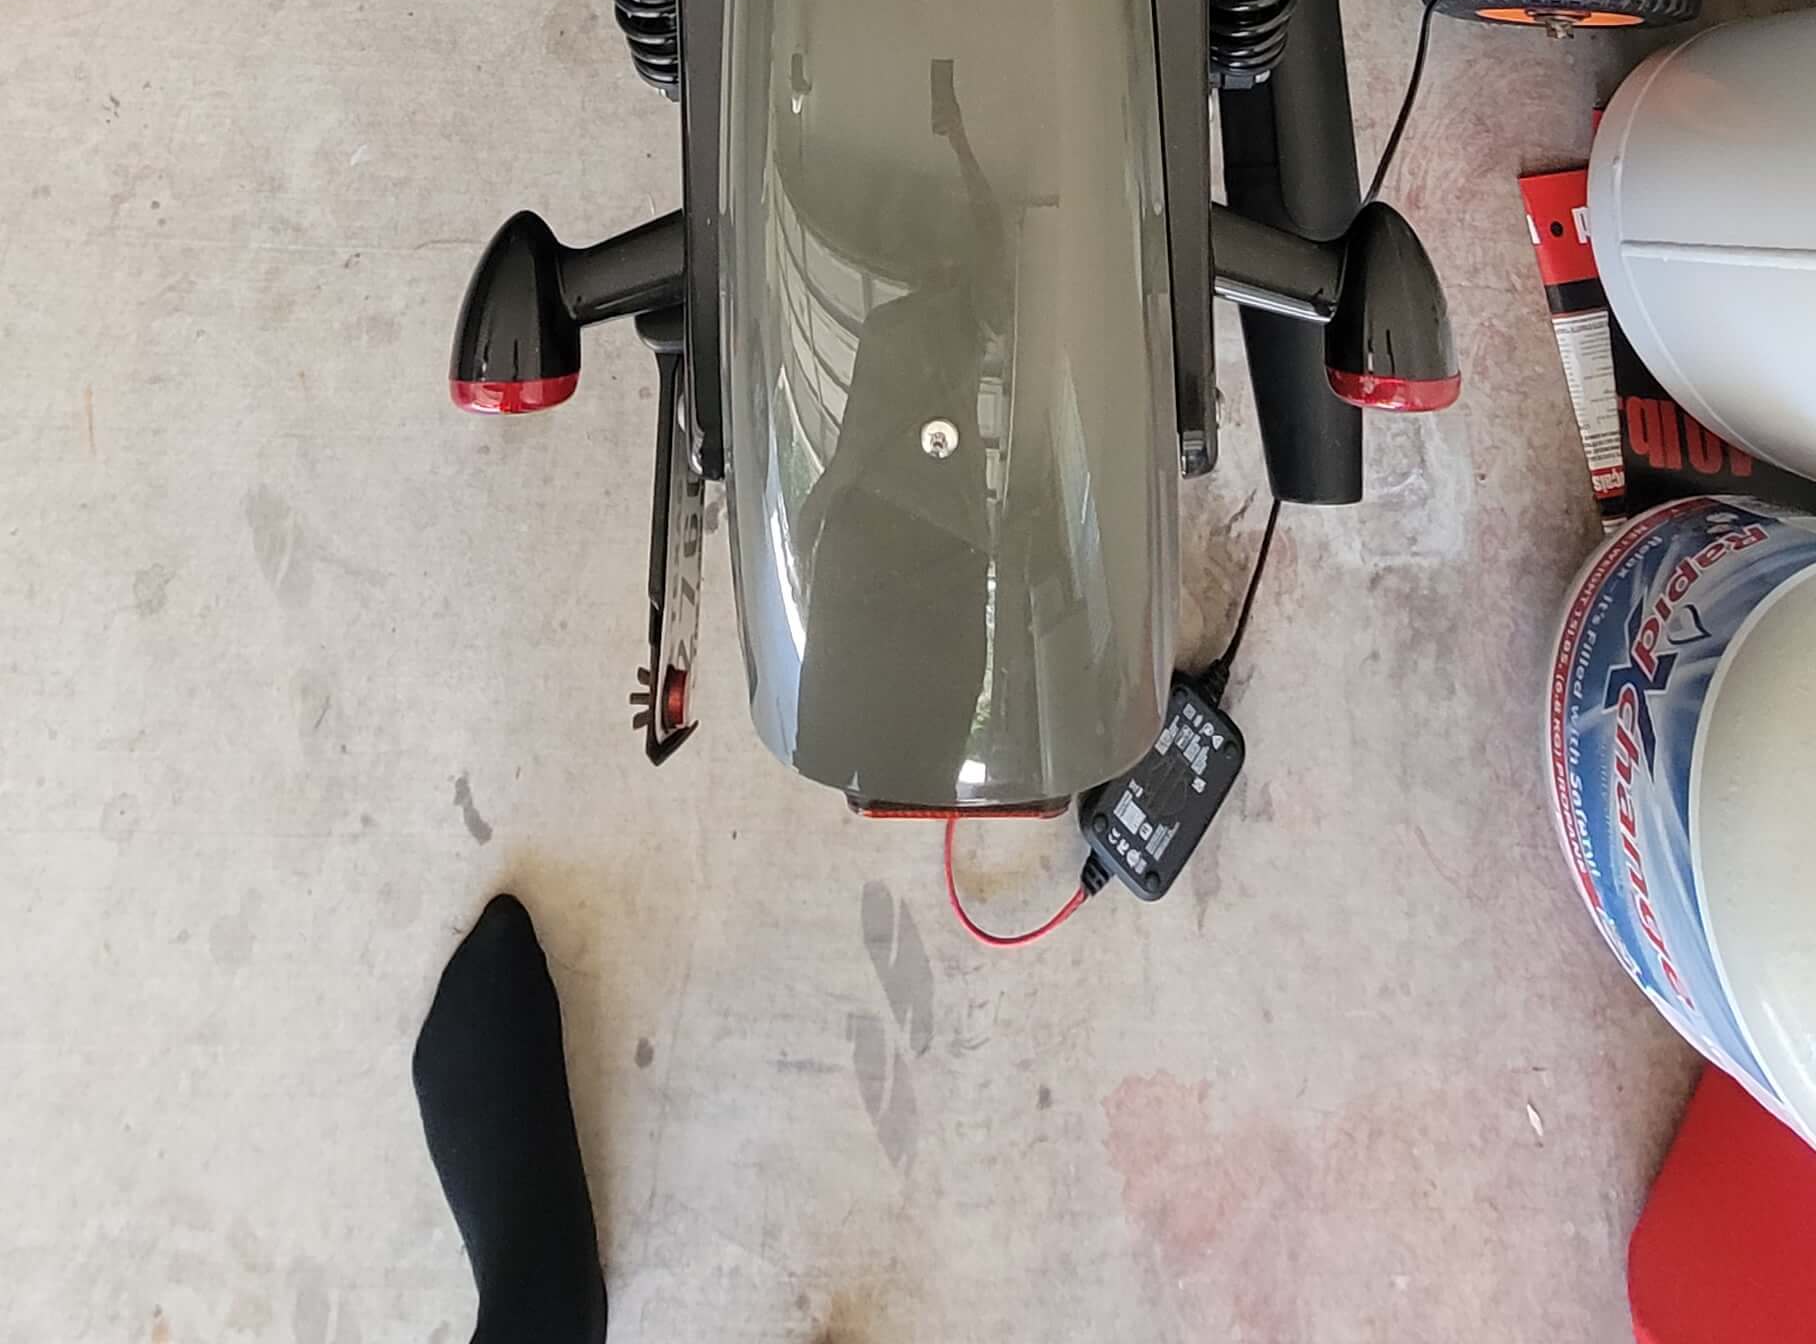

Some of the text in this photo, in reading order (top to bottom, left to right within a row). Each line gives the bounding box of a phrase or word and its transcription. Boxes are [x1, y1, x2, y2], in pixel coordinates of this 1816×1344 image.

[1576, 545, 1623, 607] WEIGHT
[1632, 524, 1769, 682] Rapid
[1569, 628, 1599, 698] Filled
[1567, 703, 1582, 764] with
